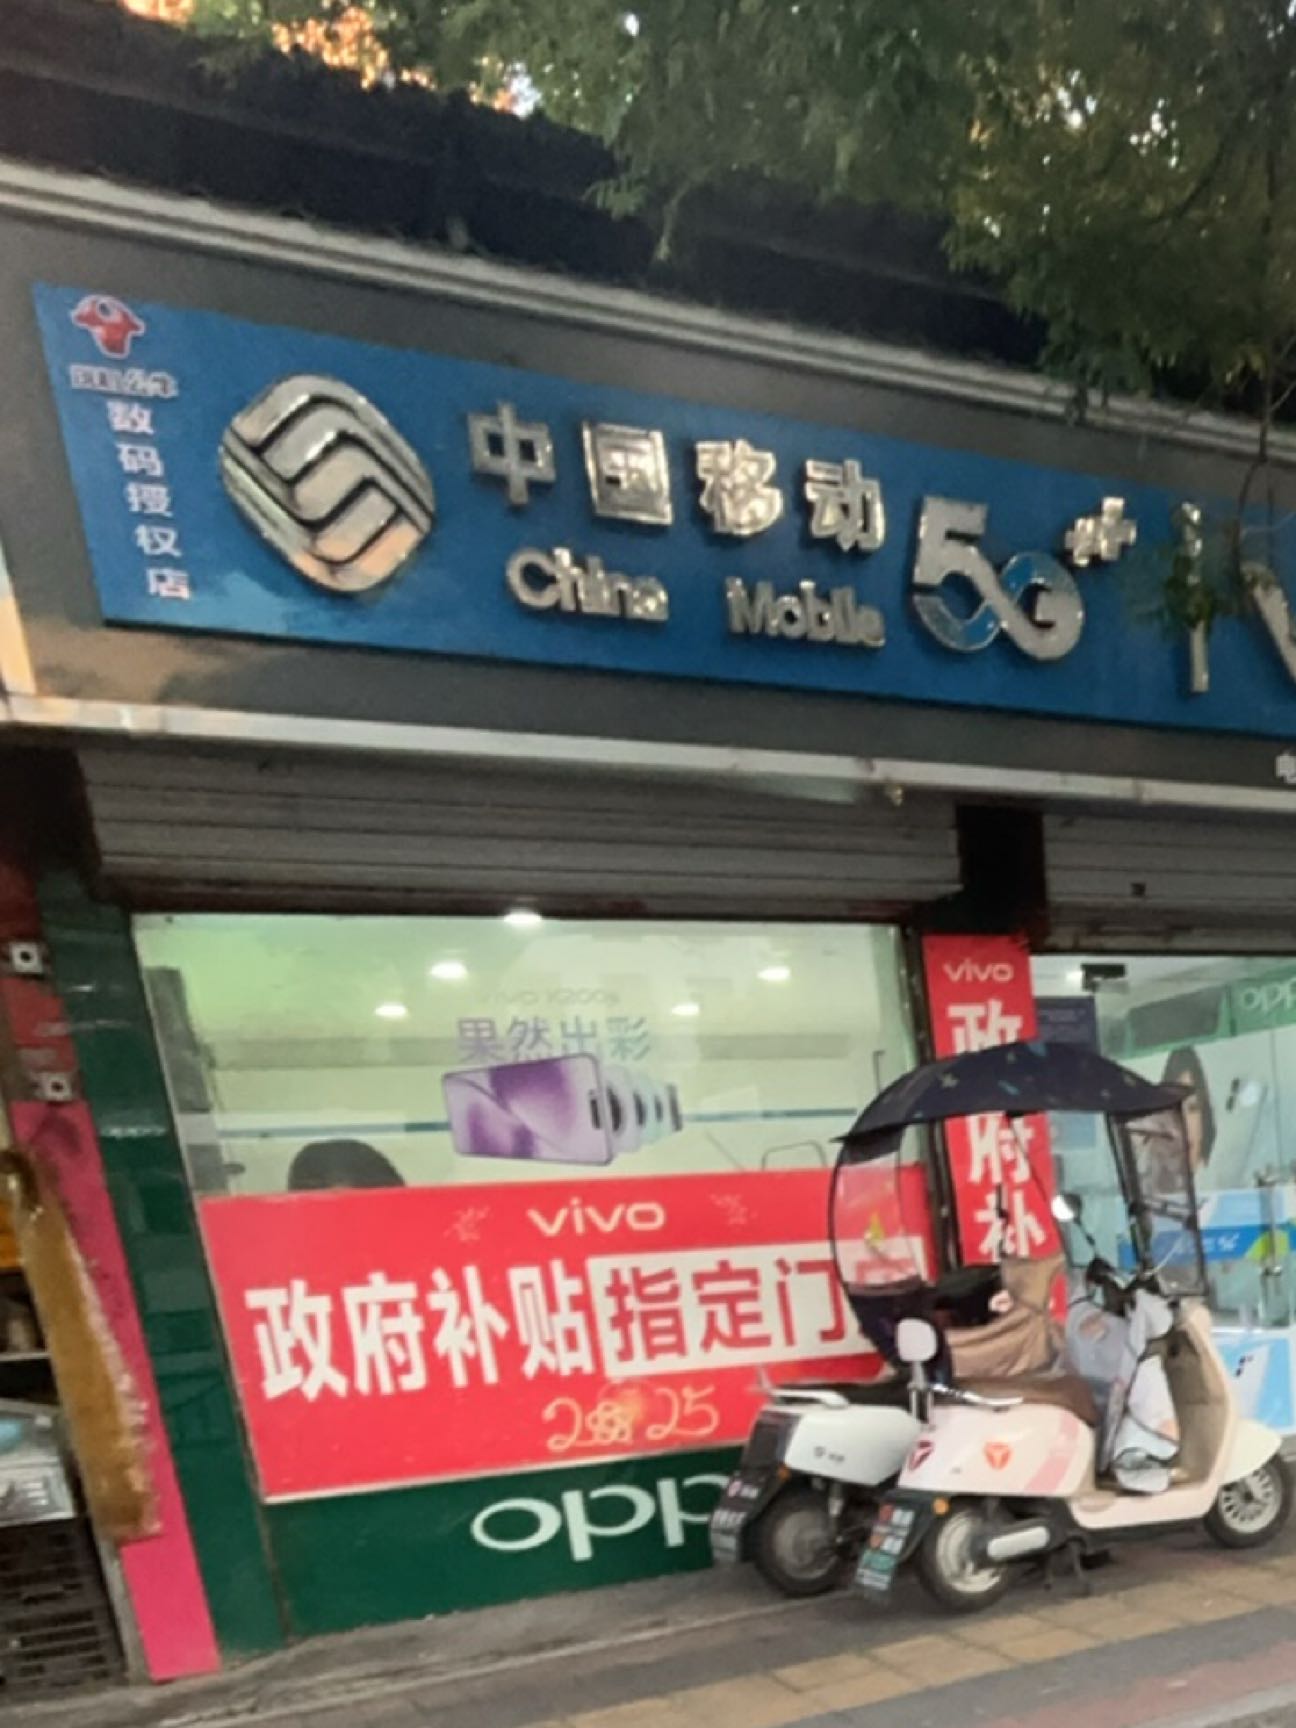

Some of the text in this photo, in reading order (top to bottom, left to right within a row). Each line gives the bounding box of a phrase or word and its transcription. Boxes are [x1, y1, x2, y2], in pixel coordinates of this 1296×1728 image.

[467, 402, 887, 554] 中国移动
[506, 546, 887, 648] China Mobile
[943, 957, 1015, 983] vivo
[458, 1014, 653, 1062] 果然出彩
[526, 1197, 667, 1238] vivo
